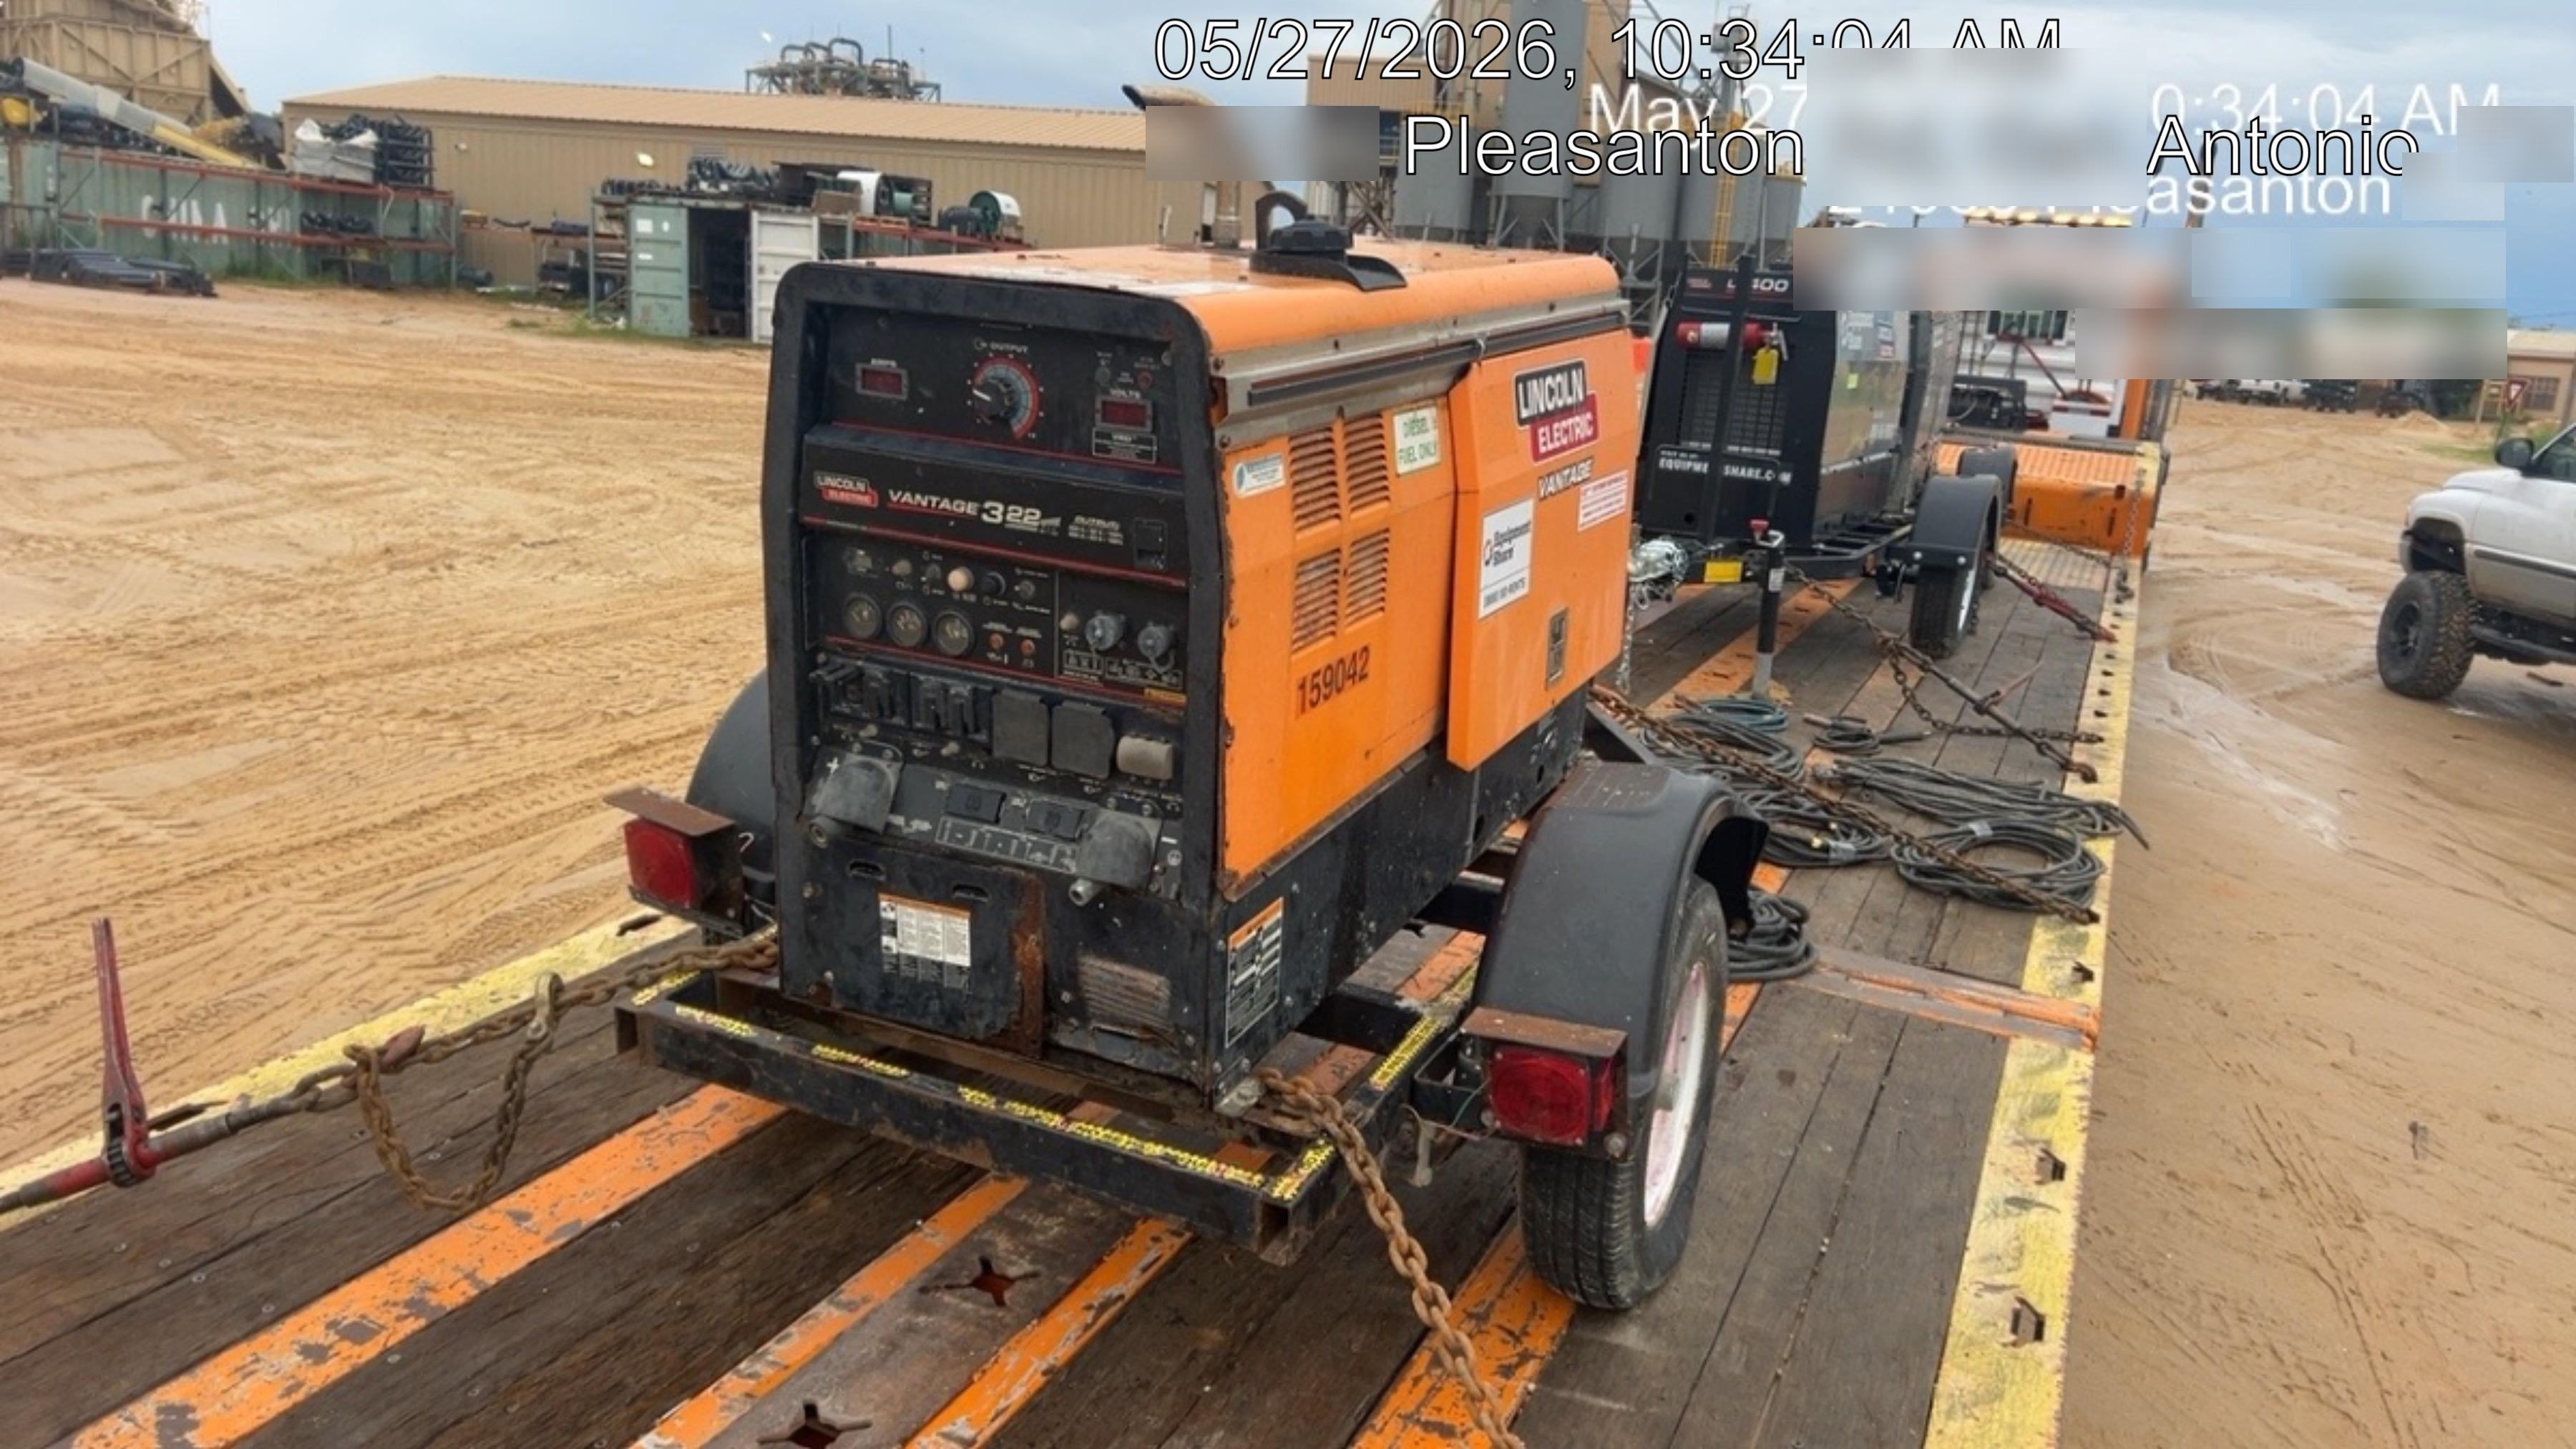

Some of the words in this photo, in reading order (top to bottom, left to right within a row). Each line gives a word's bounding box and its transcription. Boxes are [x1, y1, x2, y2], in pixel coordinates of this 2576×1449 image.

[1517, 368, 1584, 419] LINCOLN
[1538, 411, 1594, 454] ELECTRIC
[816, 474, 867, 493] LINCOLN
[1538, 456, 1595, 501] VANTAGE
[888, 488, 980, 516] VANTAGE
[980, 500, 1042, 525] 322
[1297, 645, 1370, 714] 159042
